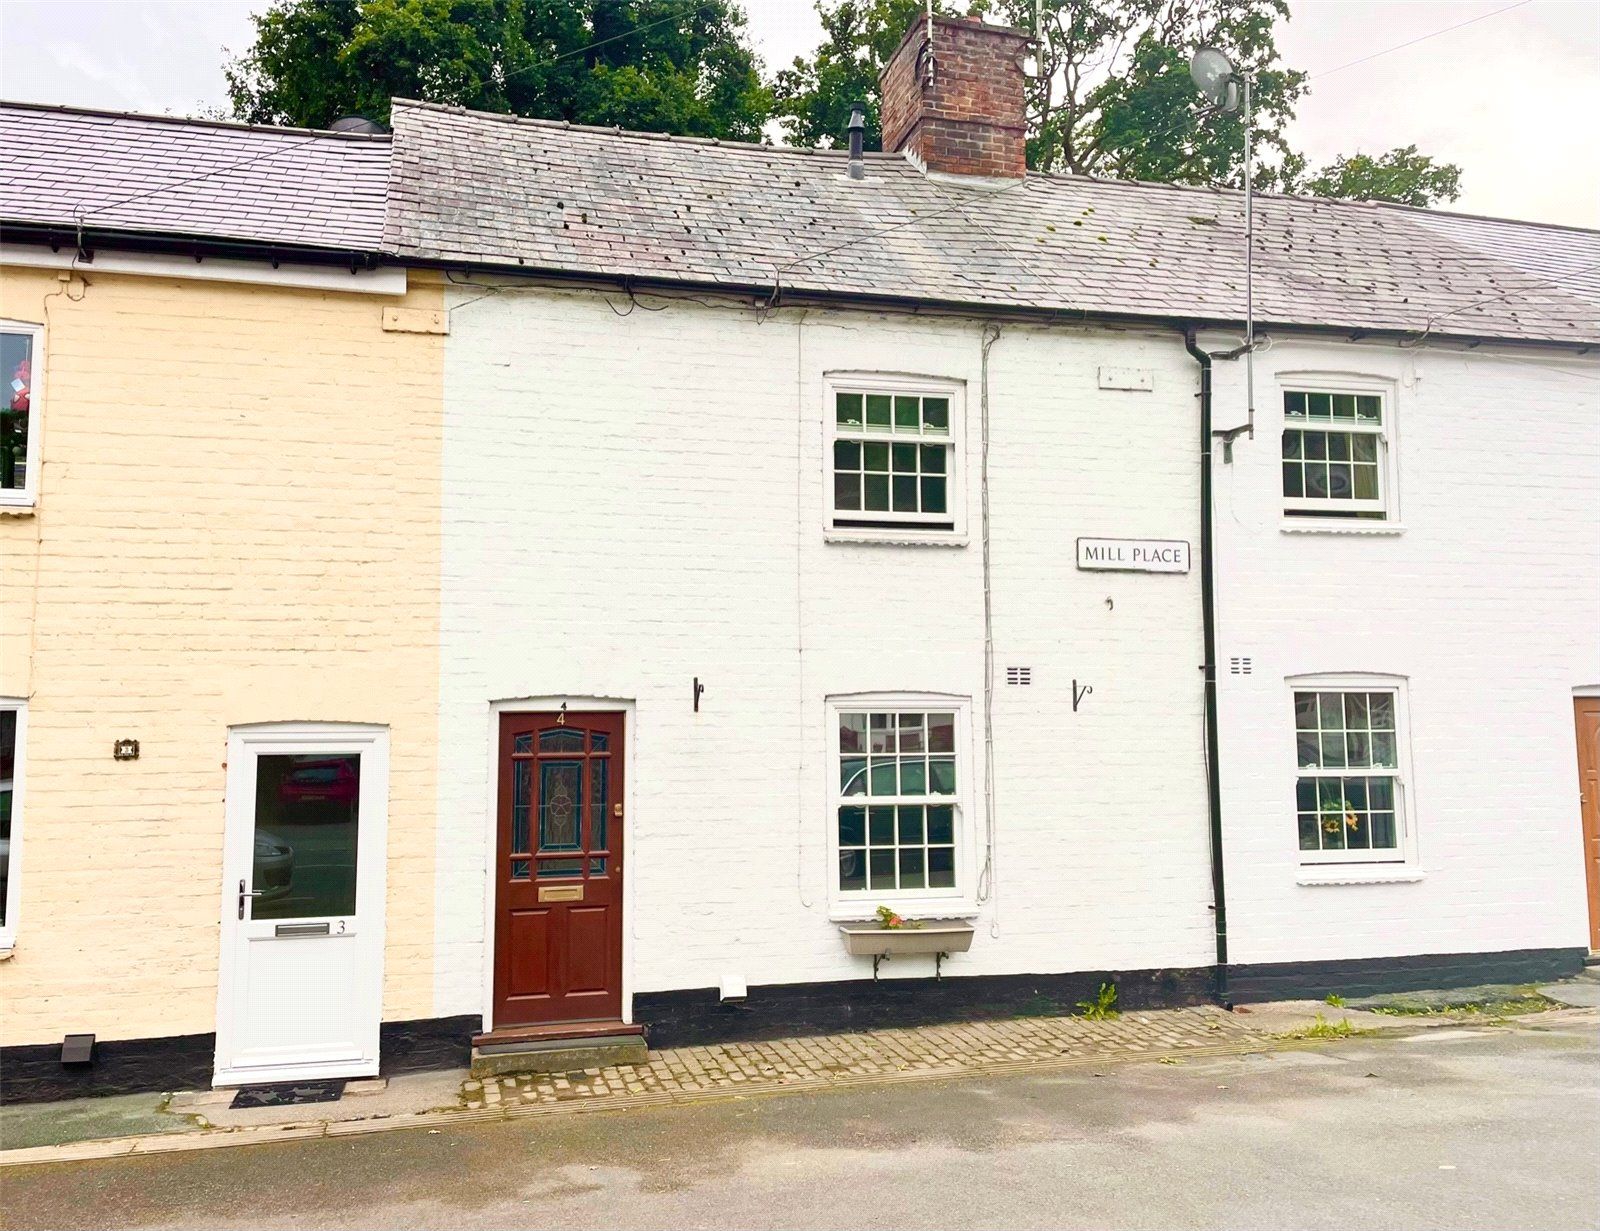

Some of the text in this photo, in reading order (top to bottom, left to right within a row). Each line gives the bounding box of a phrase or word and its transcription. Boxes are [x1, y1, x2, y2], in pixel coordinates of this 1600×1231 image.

[1085, 546, 1181, 563] MILL PLACE
[560, 701, 567, 711] 4
[557, 712, 566, 726] 4
[336, 920, 346, 935] 3
